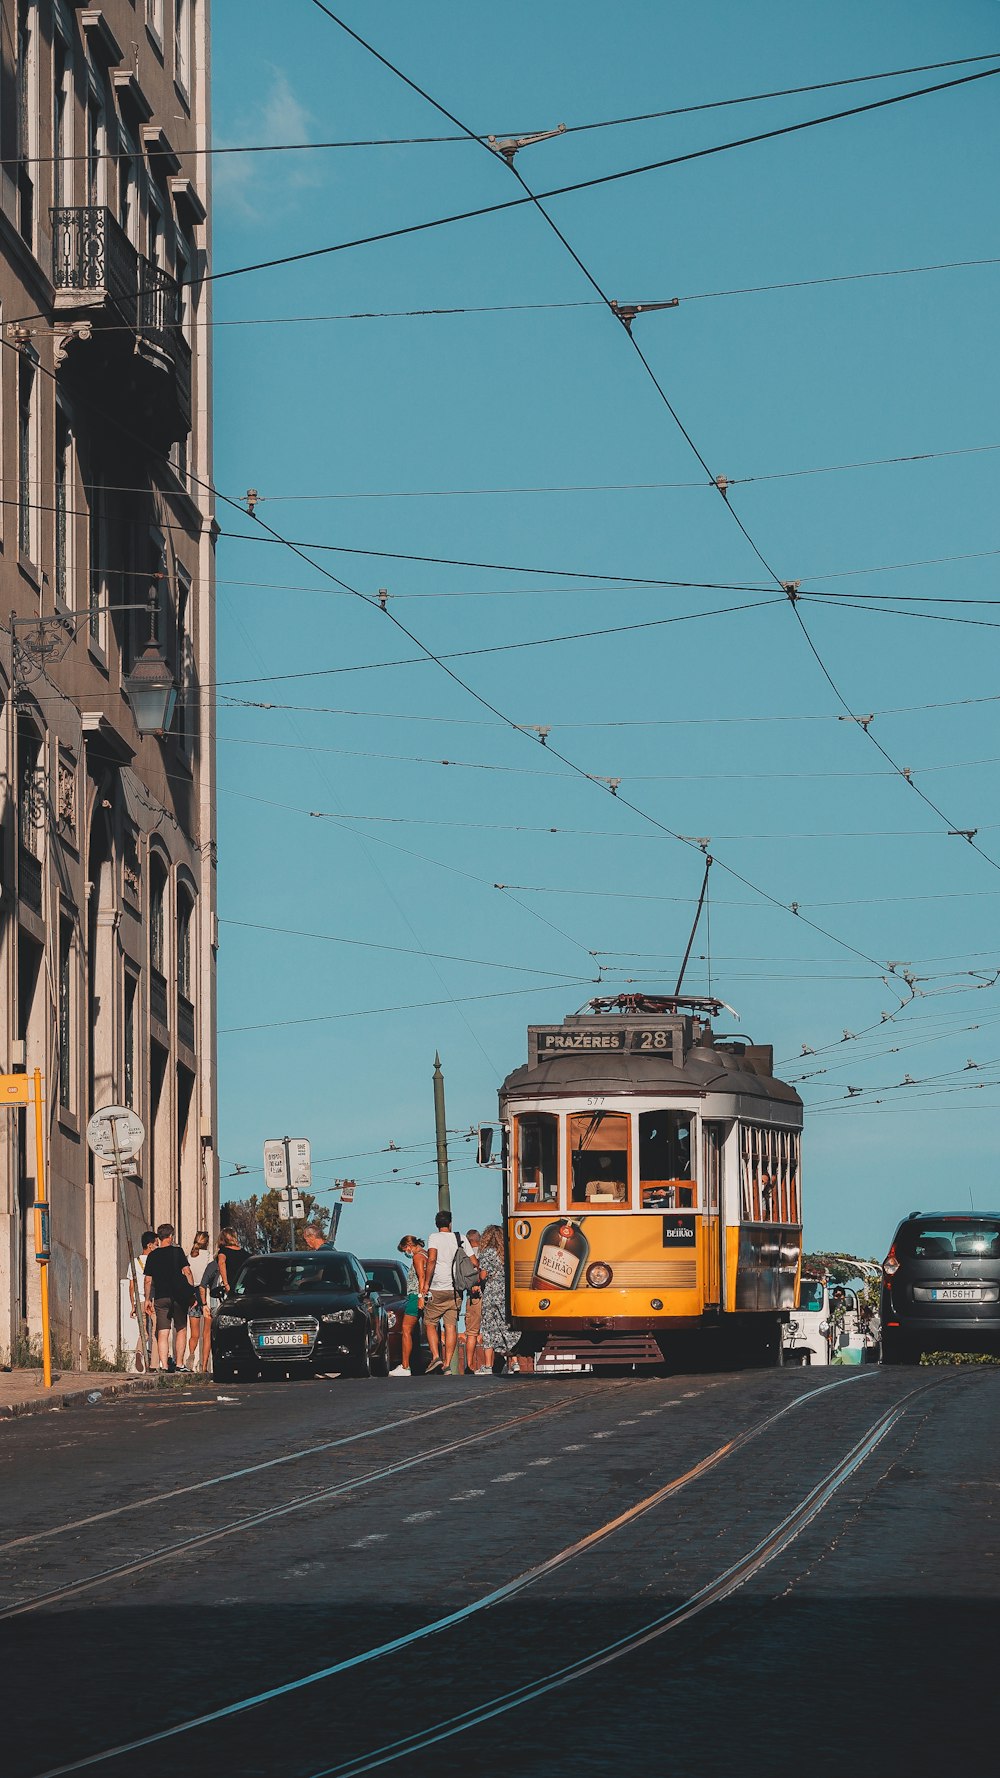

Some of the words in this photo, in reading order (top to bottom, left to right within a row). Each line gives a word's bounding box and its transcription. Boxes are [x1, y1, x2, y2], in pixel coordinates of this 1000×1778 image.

[546, 1036, 619, 1048] PRAZERES
[641, 1031, 667, 1048] 28
[587, 1097, 605, 1106] 577
